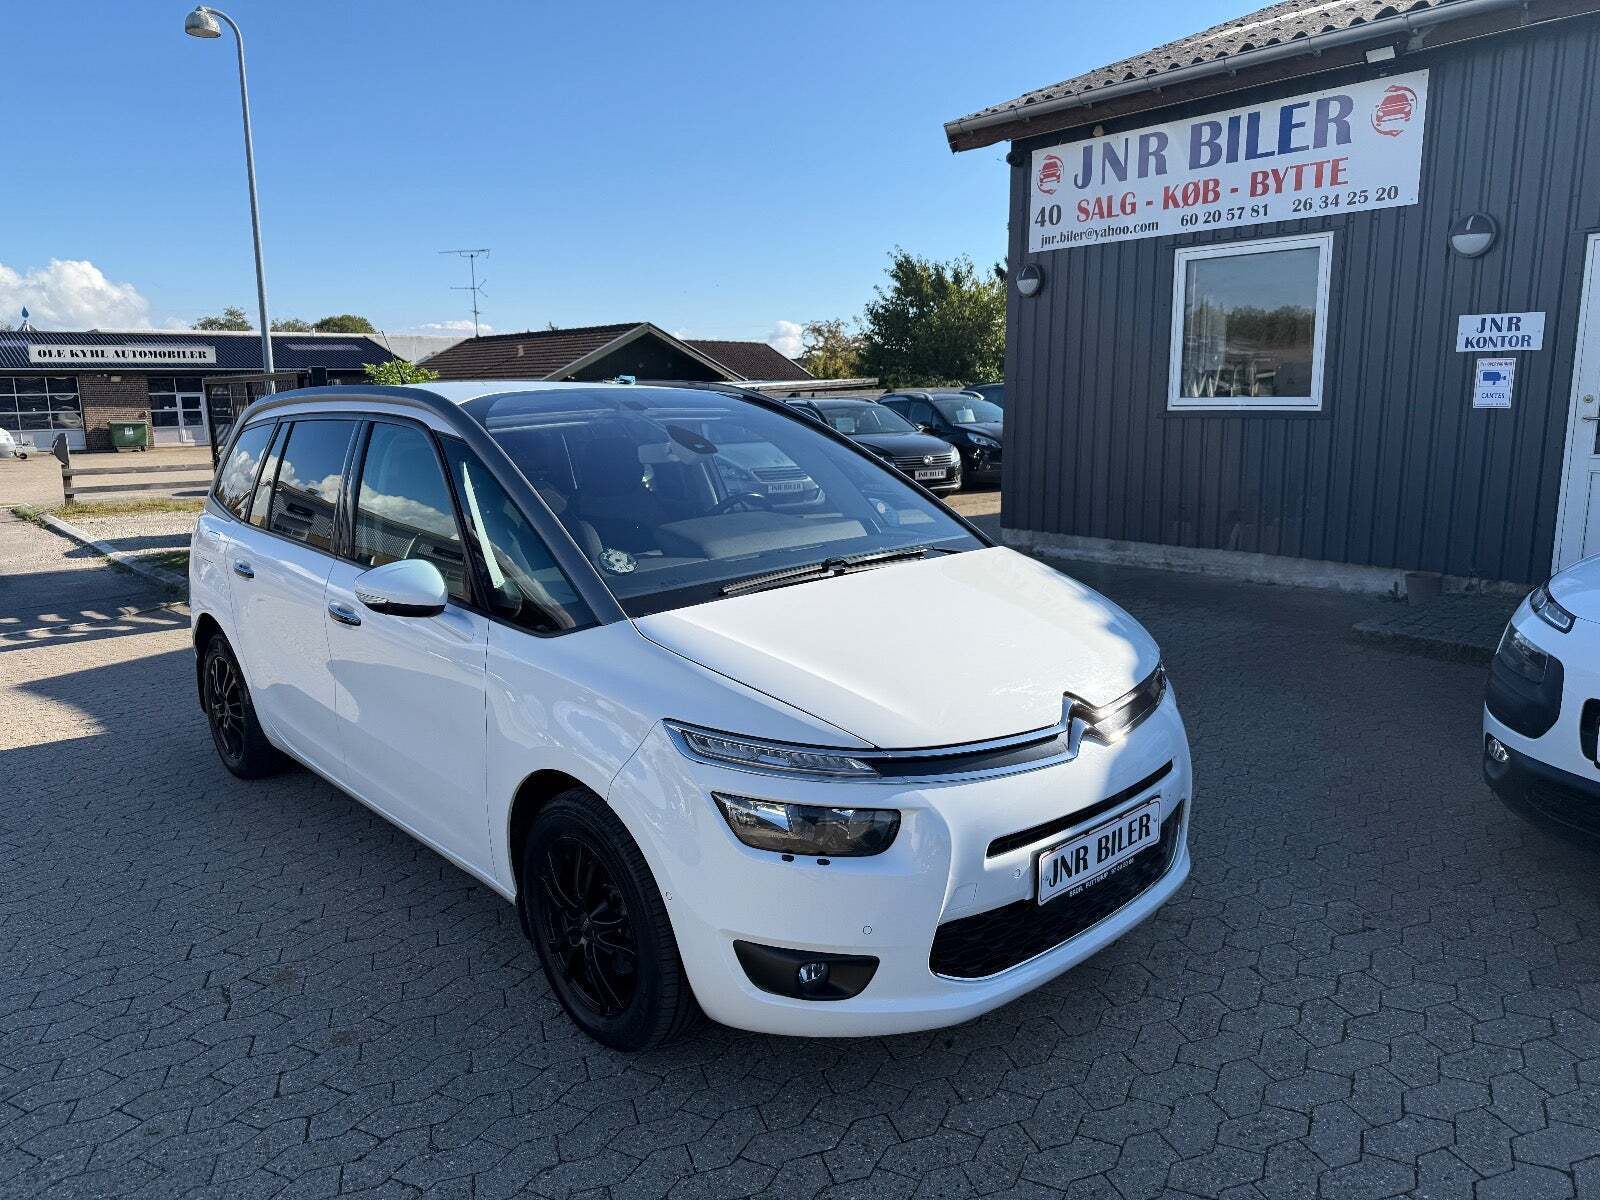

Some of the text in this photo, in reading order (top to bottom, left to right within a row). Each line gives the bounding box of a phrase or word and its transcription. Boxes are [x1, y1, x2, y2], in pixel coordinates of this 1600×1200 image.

[1073, 94, 1354, 190] JNR BILER
[1076, 191, 1137, 222] SALG
[1162, 178, 1221, 211] KØB
[1249, 157, 1349, 198] BYTTE
[1292, 185, 1399, 213] 26 34 25 20
[1034, 204, 1062, 227] 40
[1180, 203, 1269, 227] 60 20 57 81
[1040, 221, 1159, 249] jnr.biler@yahoo.com
[1476, 316, 1522, 334] JNR
[37, 349, 66, 358] OLE
[112, 349, 207, 360] AUTOMOBILER
[1464, 334, 1532, 349] KONTOR
[1048, 844, 1089, 888] JNR
[1096, 812, 1151, 864] BILER
